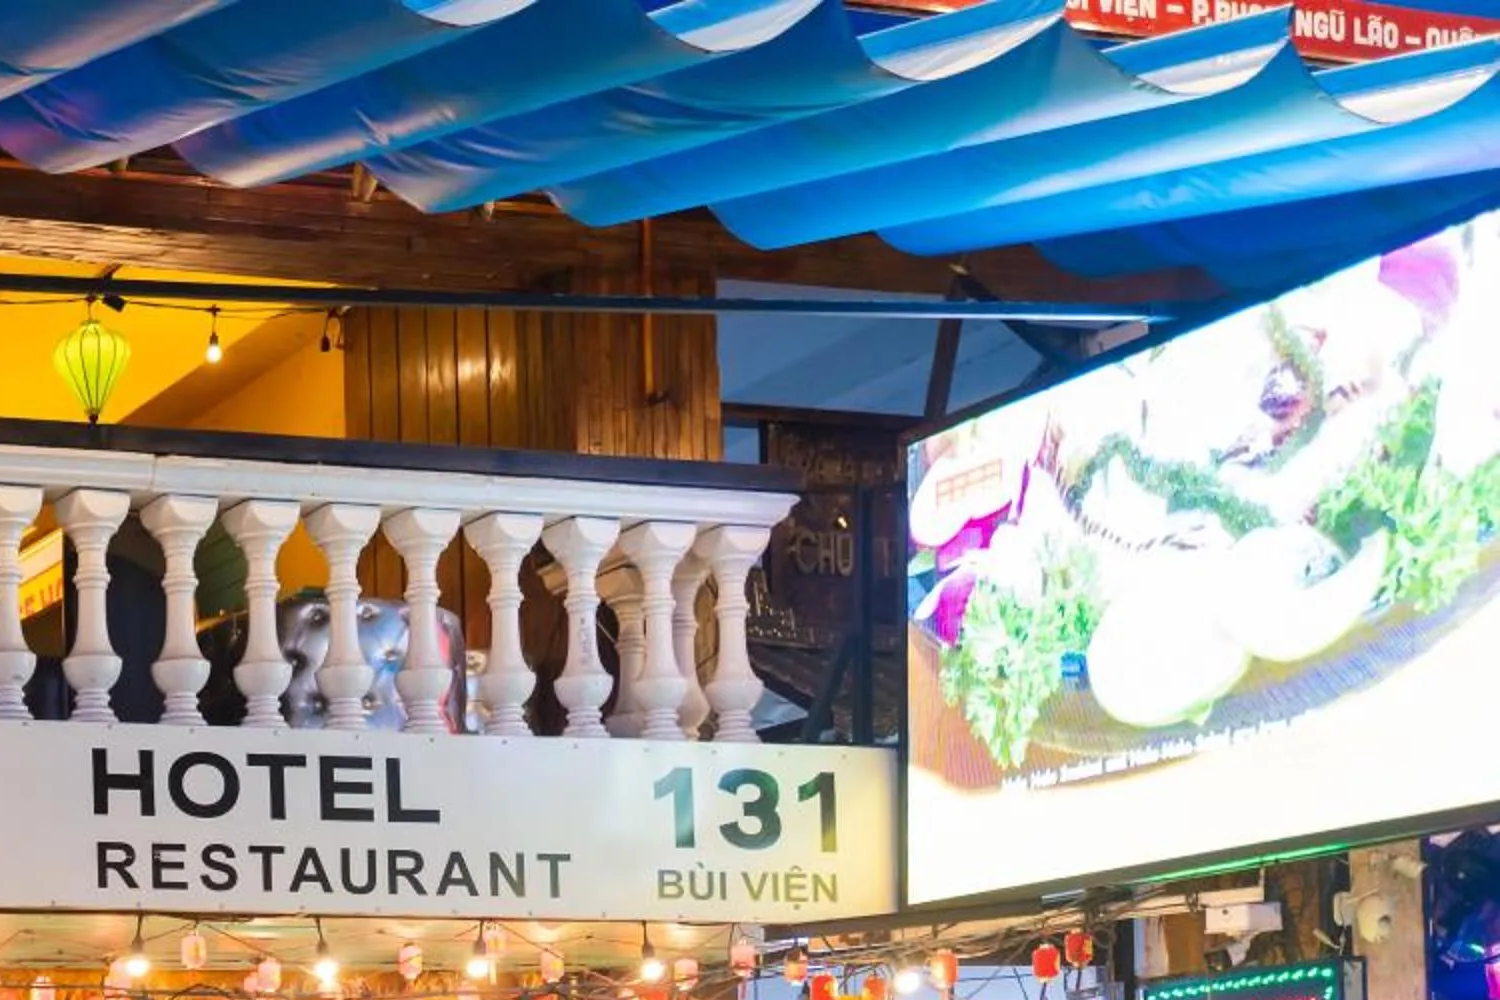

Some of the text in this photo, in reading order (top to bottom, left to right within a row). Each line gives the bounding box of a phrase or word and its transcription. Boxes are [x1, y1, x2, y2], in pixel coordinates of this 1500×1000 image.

[1295, 9, 1346, 42] NGŨ
[1353, 14, 1399, 50] LÃO
[91, 747, 441, 825] HOTEL
[653, 766, 839, 853] 131
[96, 841, 571, 899] RESTAURANT
[656, 862, 839, 911] BÙI VIỆN
